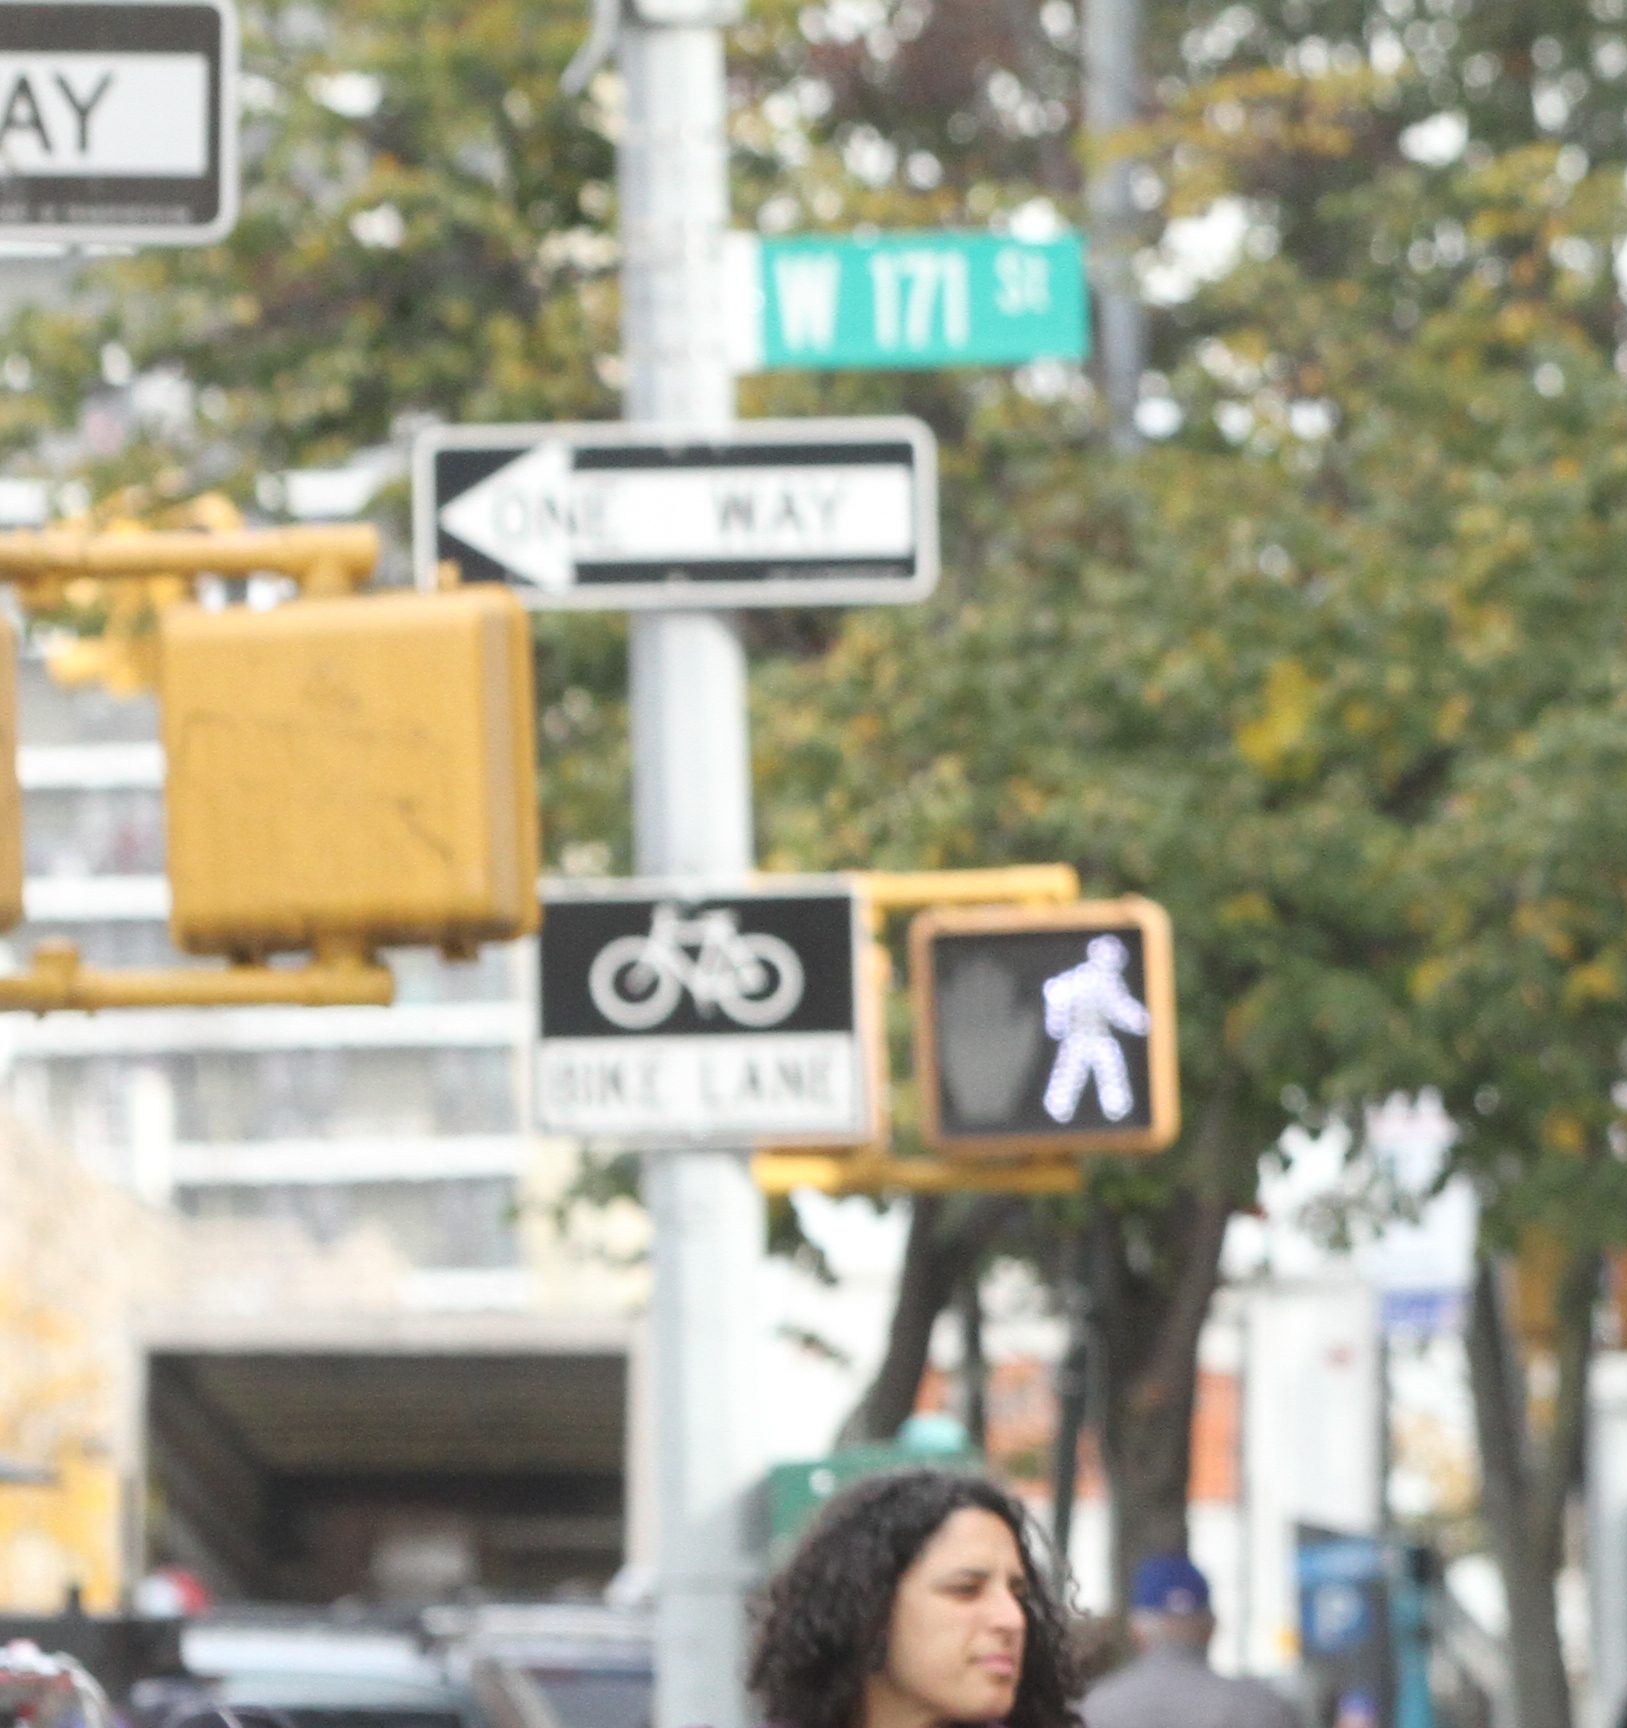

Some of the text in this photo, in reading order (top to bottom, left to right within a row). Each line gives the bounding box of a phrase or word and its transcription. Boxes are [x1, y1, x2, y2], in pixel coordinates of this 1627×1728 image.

[774, 252, 842, 352] W
[868, 250, 970, 350] 171
[492, 488, 842, 540] ONE WAY
[551, 1054, 834, 1106] BIKE LANE
